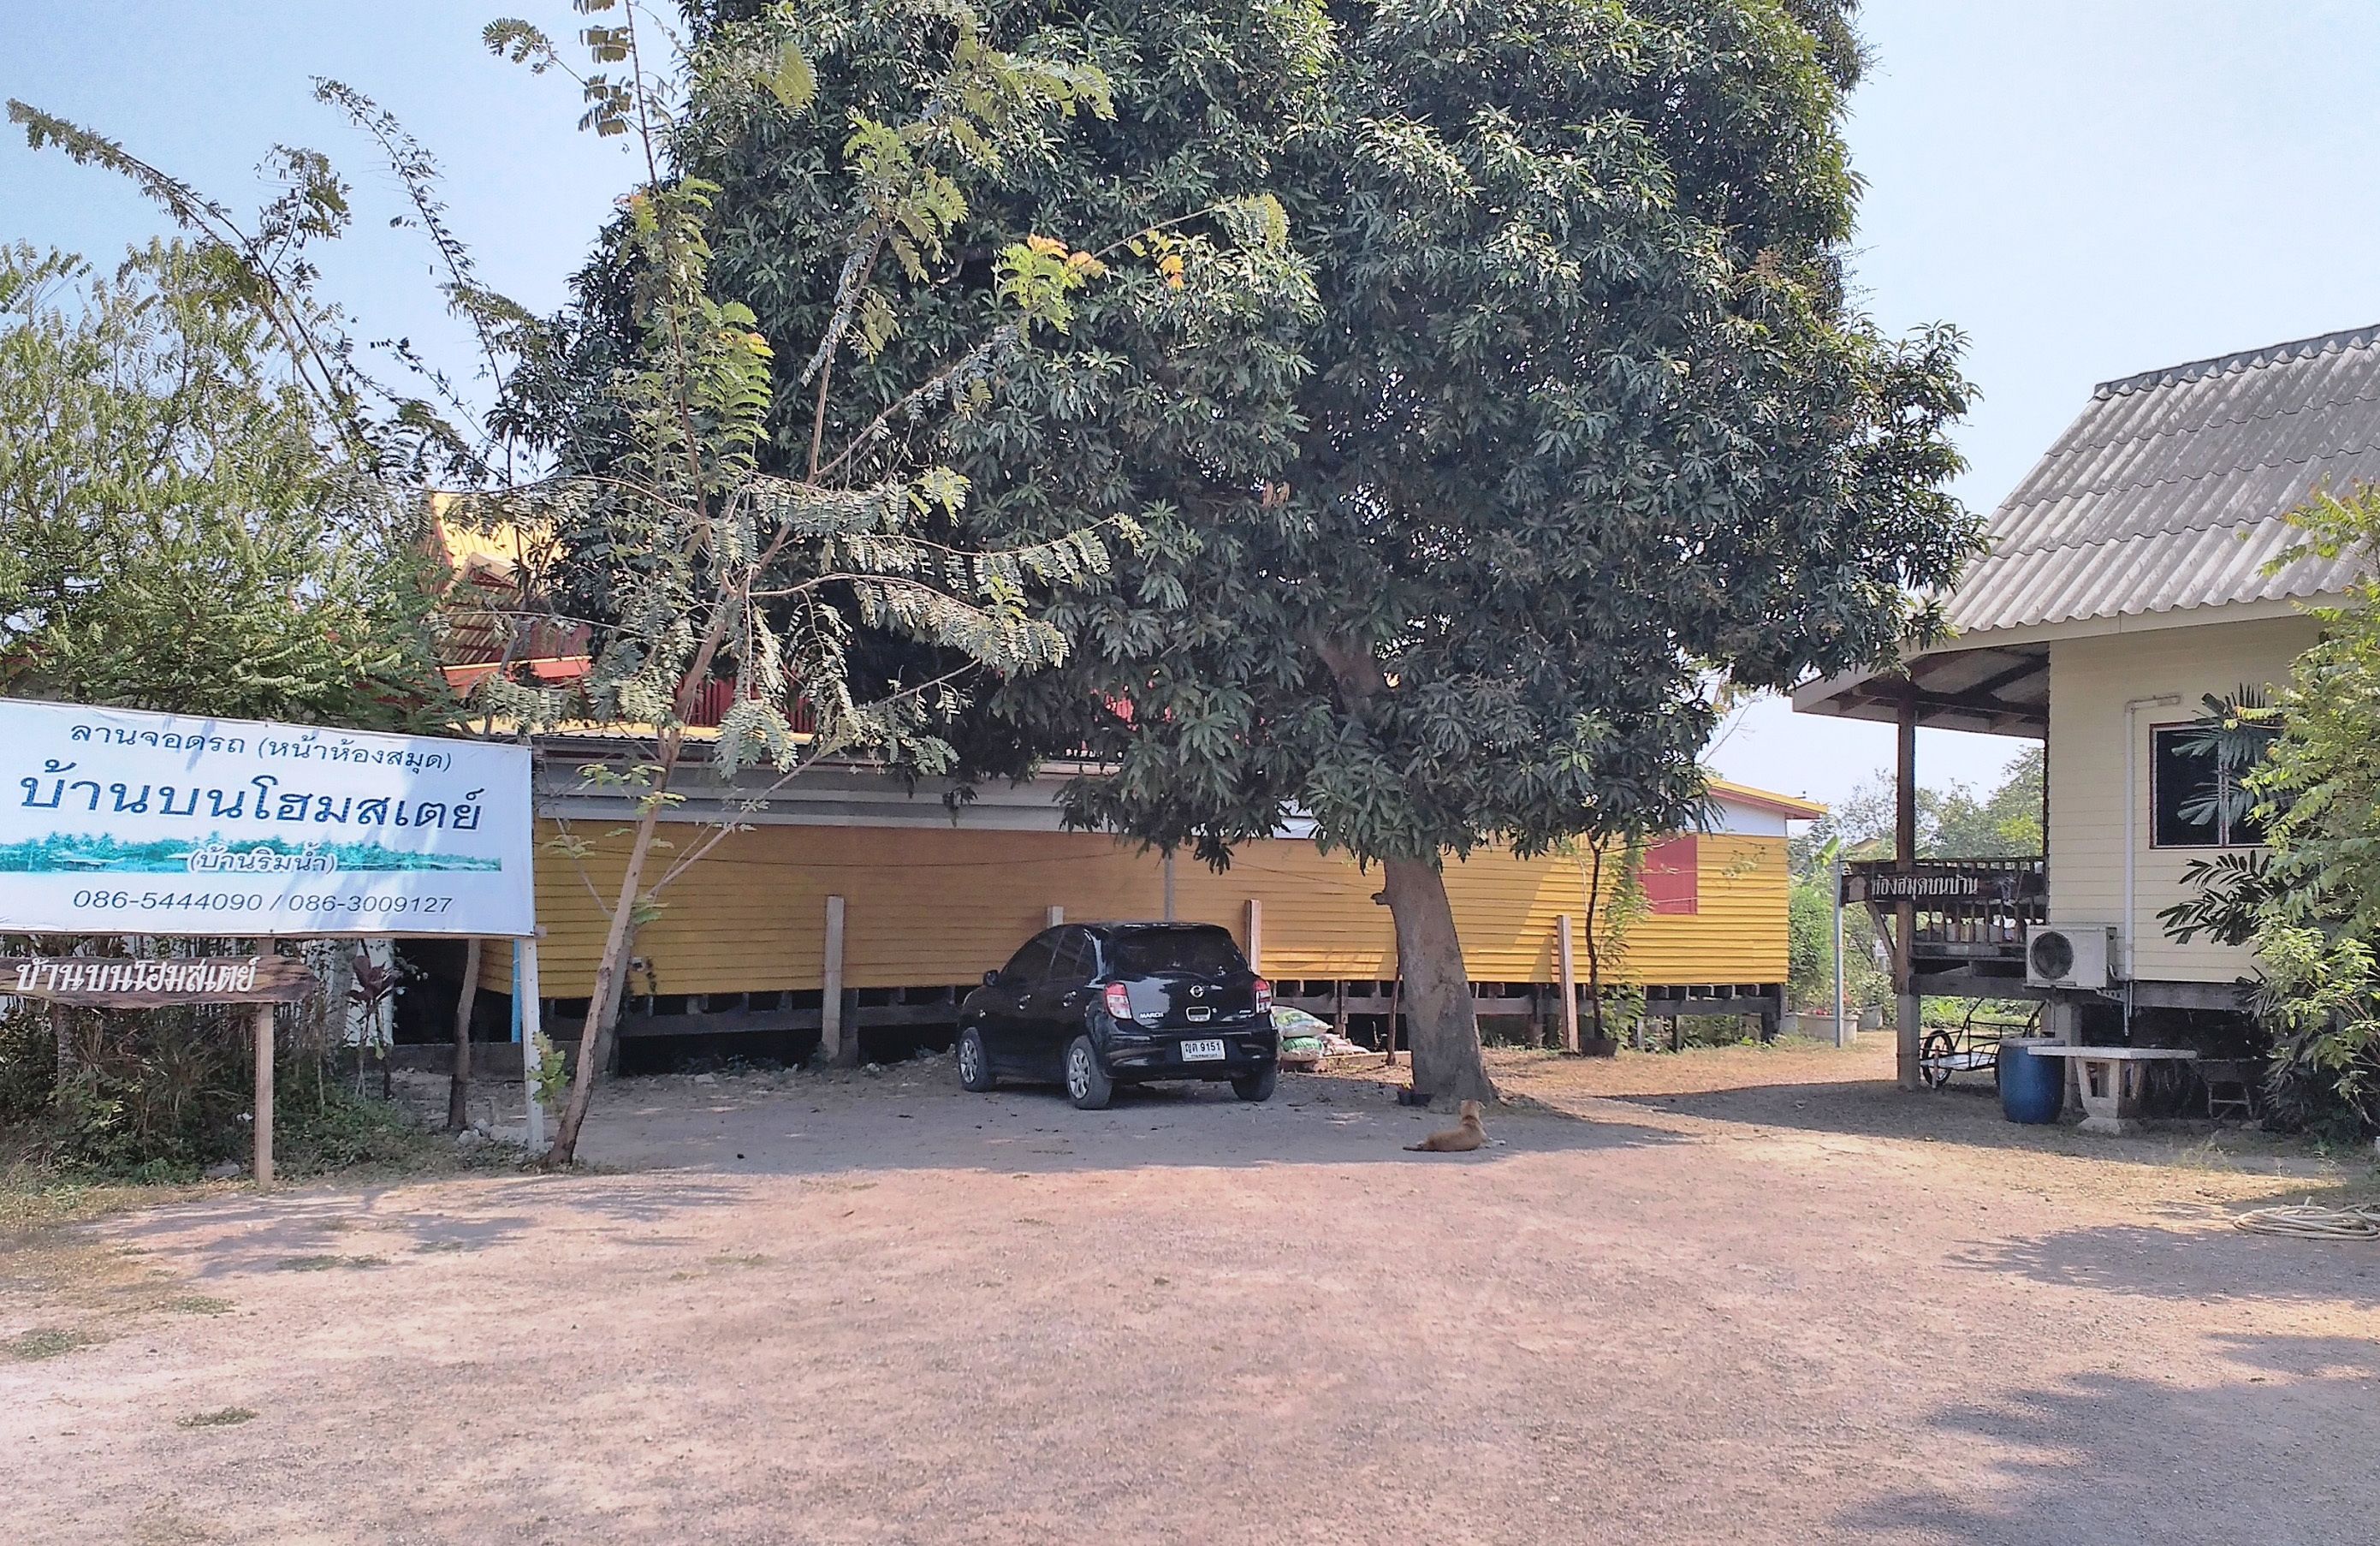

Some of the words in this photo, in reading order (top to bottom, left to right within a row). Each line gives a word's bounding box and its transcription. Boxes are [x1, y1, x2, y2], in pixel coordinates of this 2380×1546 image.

[71, 723, 246, 754] ลานจอดรถ
[258, 734, 452, 774] (หน้าห้องสมุด)
[20, 758, 486, 831] บ้านบนโฮมสเตย์
[190, 841, 335, 875] (บ้านริมน้ำ)
[73, 889, 263, 912] 086-5444090
[288, 895, 454, 914] 086-3009127
[15, 956, 261, 993] บ้านบนโฮมสเตย์
[1200, 1042, 1220, 1052] 9151
